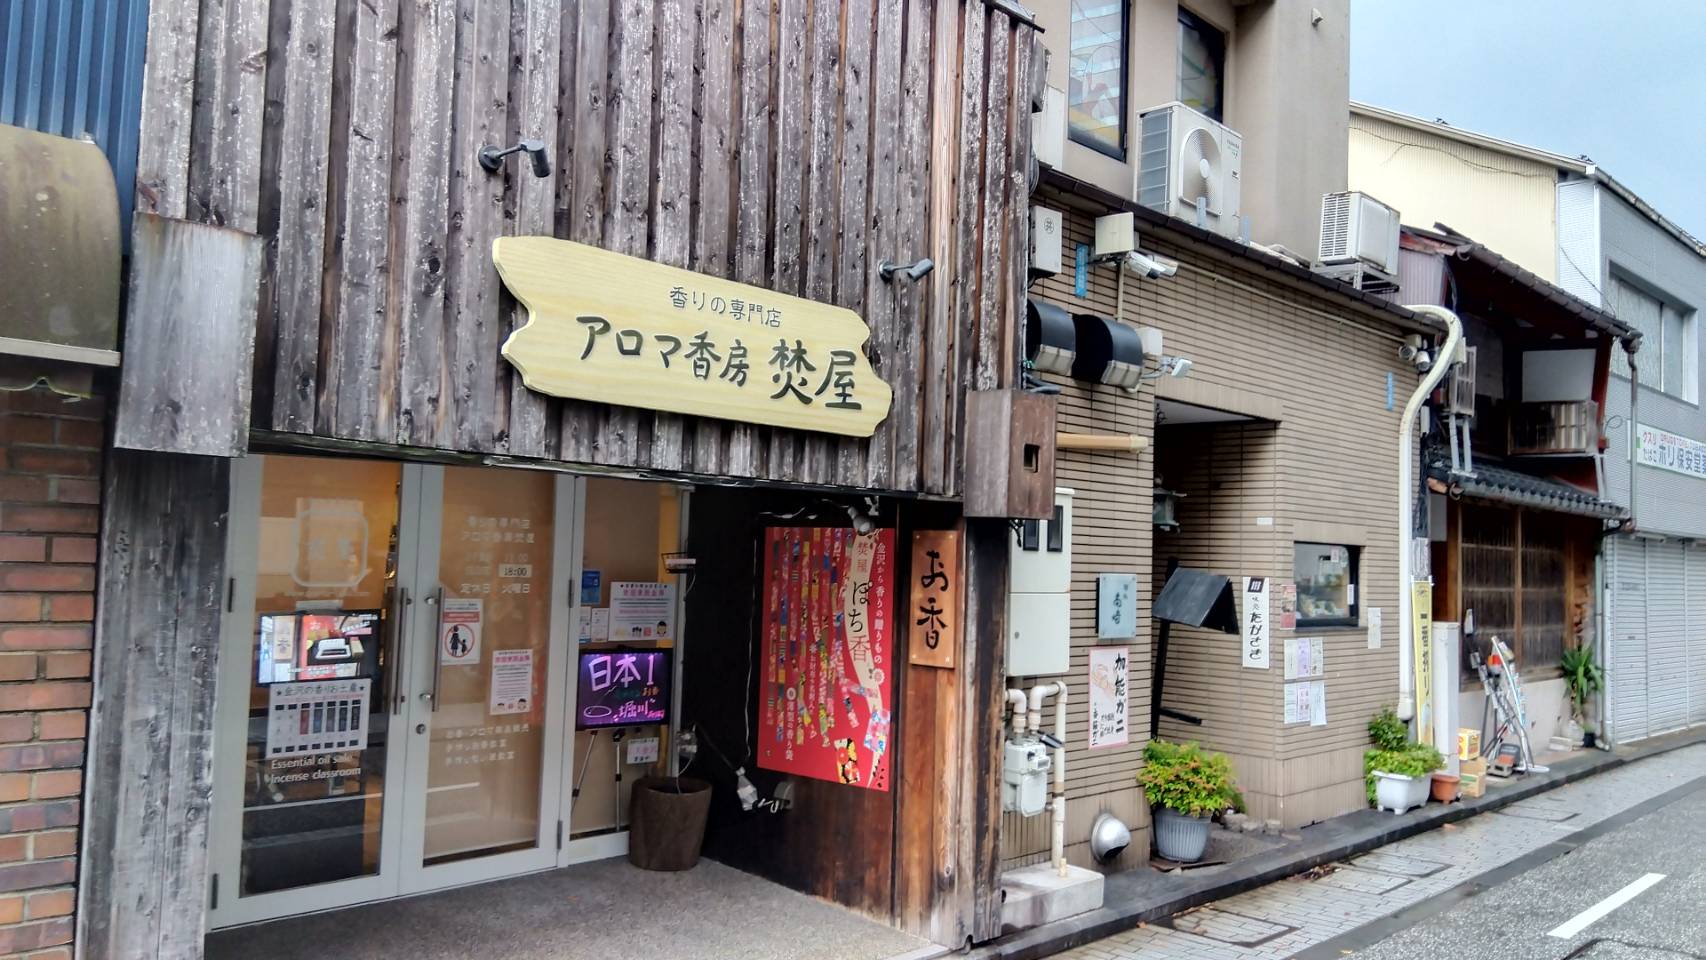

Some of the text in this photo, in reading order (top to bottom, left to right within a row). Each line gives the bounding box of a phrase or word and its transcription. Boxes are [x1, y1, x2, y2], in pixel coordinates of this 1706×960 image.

[669, 286, 783, 328] 香りの専門店
[576, 315, 862, 410] アロマ香房 焚屋
[503, 567, 528, 576] 18:00
[917, 550, 949, 649] お香
[271, 757, 316, 770] Essential
[317, 756, 331, 765] oil
[271, 767, 361, 784] Incense classroom
